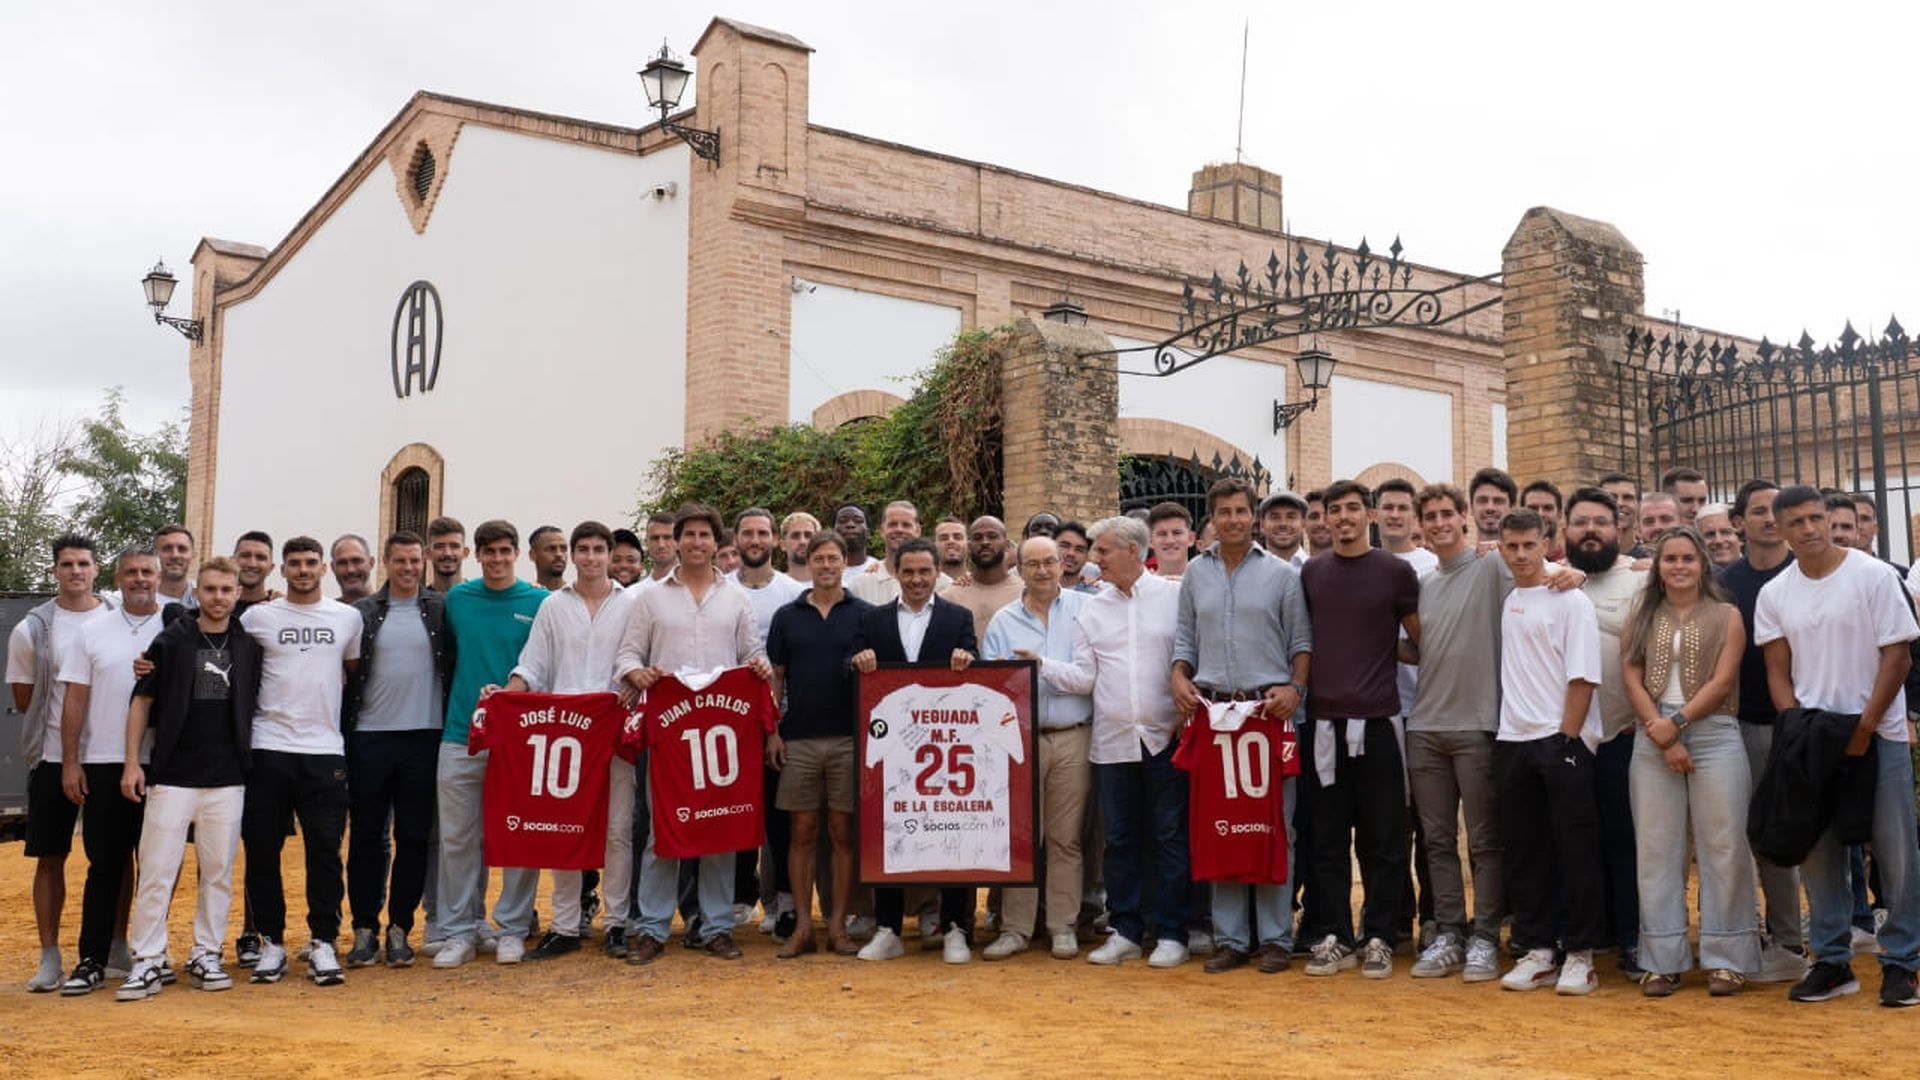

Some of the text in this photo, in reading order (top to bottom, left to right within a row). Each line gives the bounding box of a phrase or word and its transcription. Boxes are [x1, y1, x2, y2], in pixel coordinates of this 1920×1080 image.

[279, 628, 334, 644] AIR
[519, 706, 593, 730] JOSÉ LUIS
[657, 693, 751, 728] JUAN CARLOS
[911, 709, 979, 725] YEGUADA
[930, 728, 961, 743] M.F.
[680, 724, 740, 790] 10
[1213, 731, 1270, 798] 10
[526, 733, 582, 799] 10
[915, 744, 976, 797] 25
[694, 803, 754, 820] socios.com
[893, 800, 993, 813] DE LA ESCALERA
[523, 821, 585, 833] socios.com
[923, 821, 988, 832] socios.com
